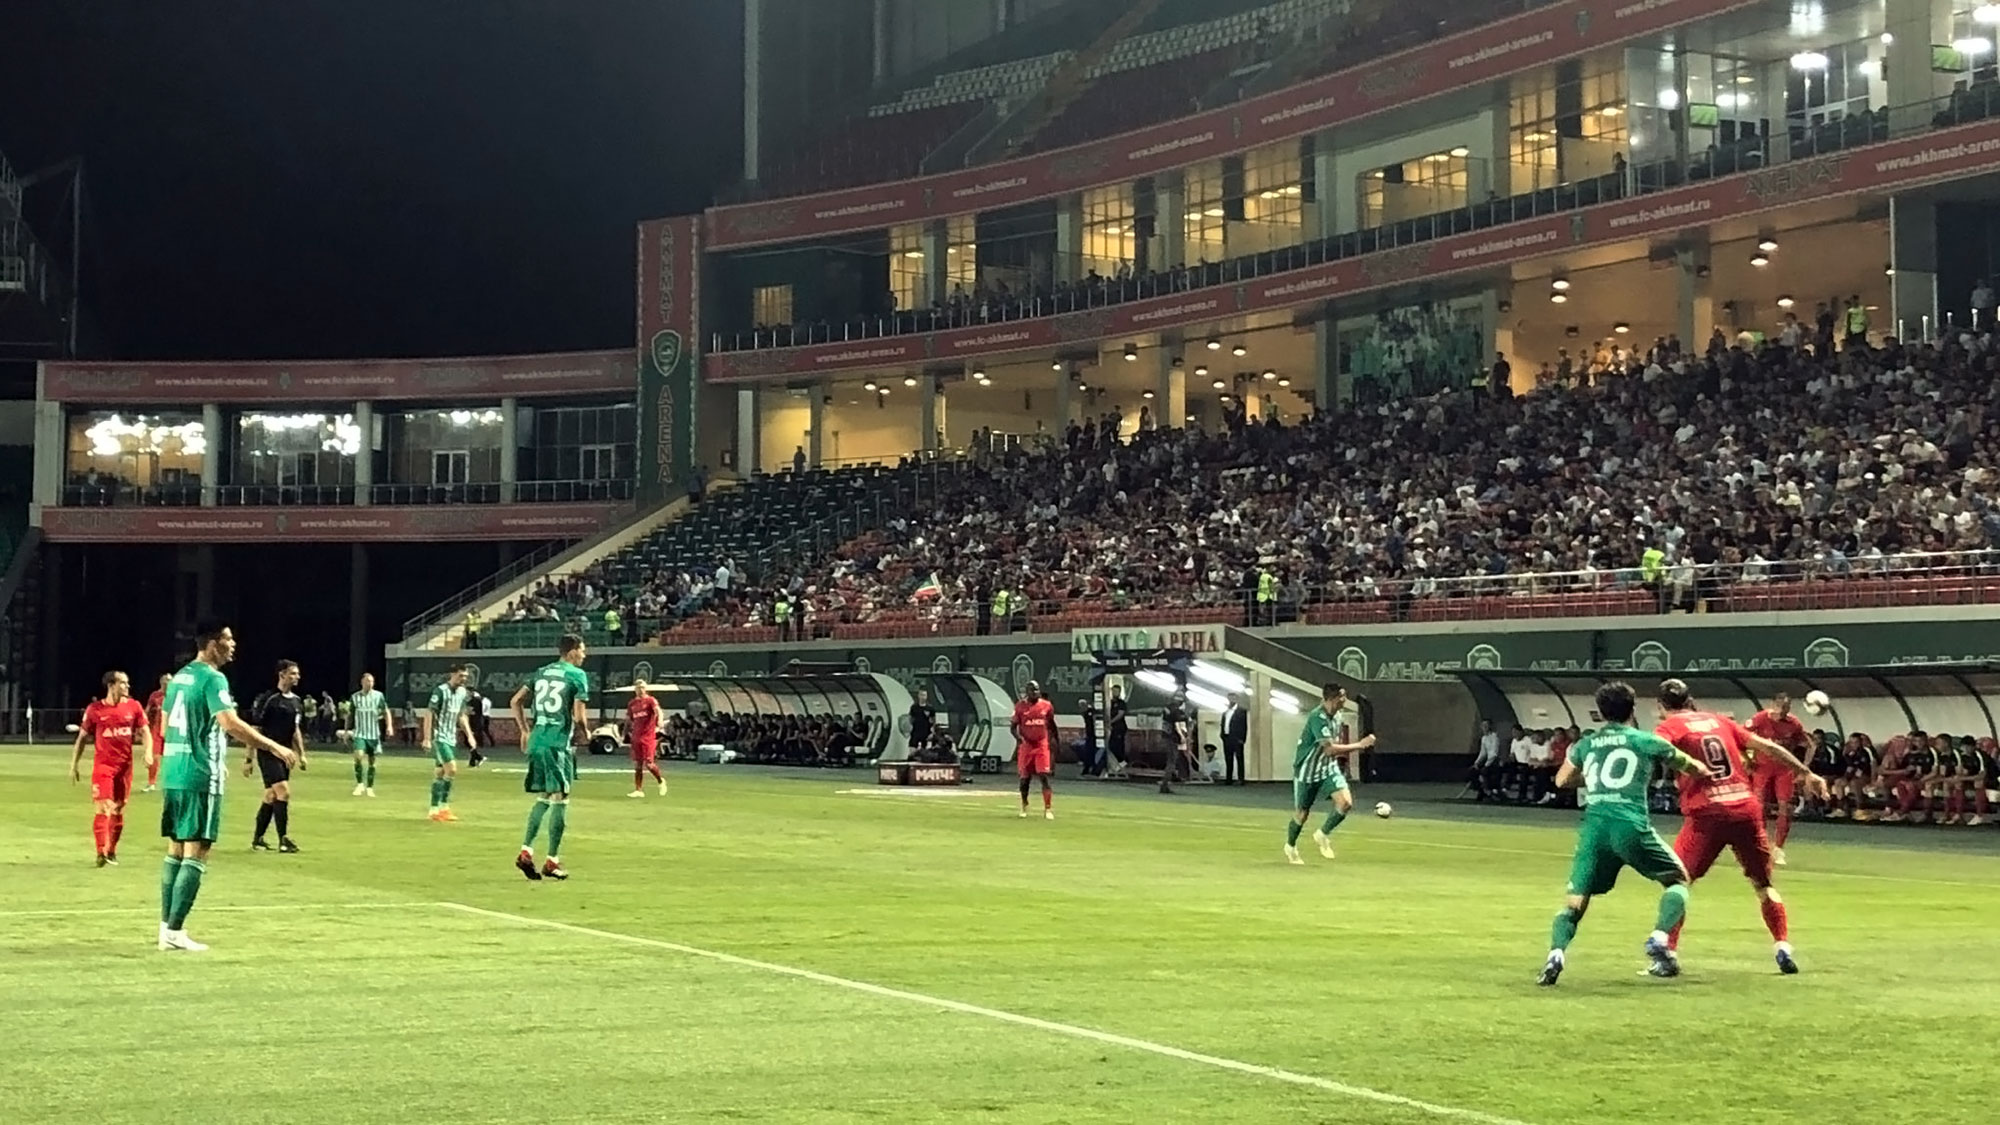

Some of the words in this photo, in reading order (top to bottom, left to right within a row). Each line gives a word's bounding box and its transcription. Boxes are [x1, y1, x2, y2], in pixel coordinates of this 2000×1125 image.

[1448, 31, 1554, 69] www.akhmat-arena.ru
[1609, 199, 1711, 228] www.fc-akhmat.ru
[1452, 230, 1556, 259] www.akhmat-arena.ru
[657, 384, 674, 484] ARENA
[1157, 630, 1220, 653] АРЕНА
[168, 690, 188, 738] 4
[535, 679, 566, 713] 23
[1583, 748, 1639, 792] 40
[1701, 735, 1733, 781] 9
